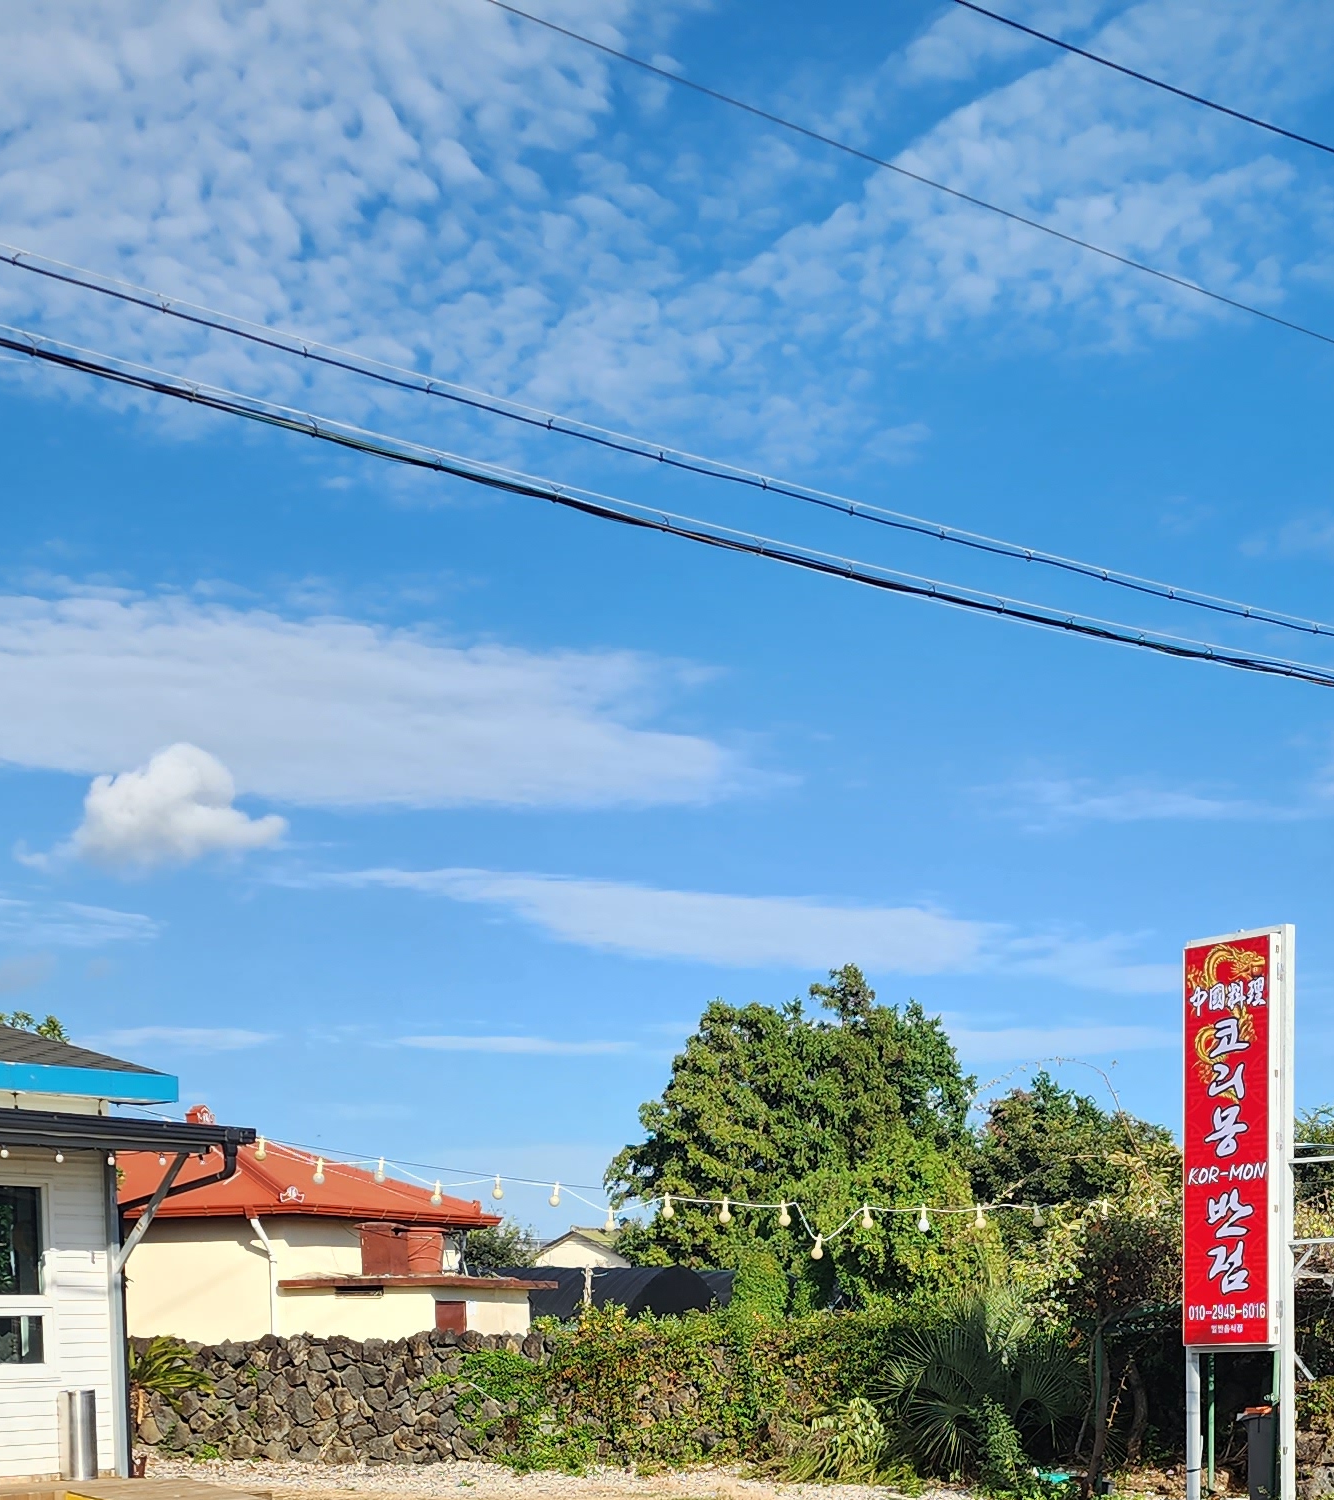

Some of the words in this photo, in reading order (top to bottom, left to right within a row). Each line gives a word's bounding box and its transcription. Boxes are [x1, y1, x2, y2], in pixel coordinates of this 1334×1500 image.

[1190, 977, 1266, 1017] 中國料理
[1188, 1162, 1266, 1185] KOR-MON
[1205, 1187, 1254, 1295] 반점
[1189, 1303, 1266, 1321] 010-2949-6016
